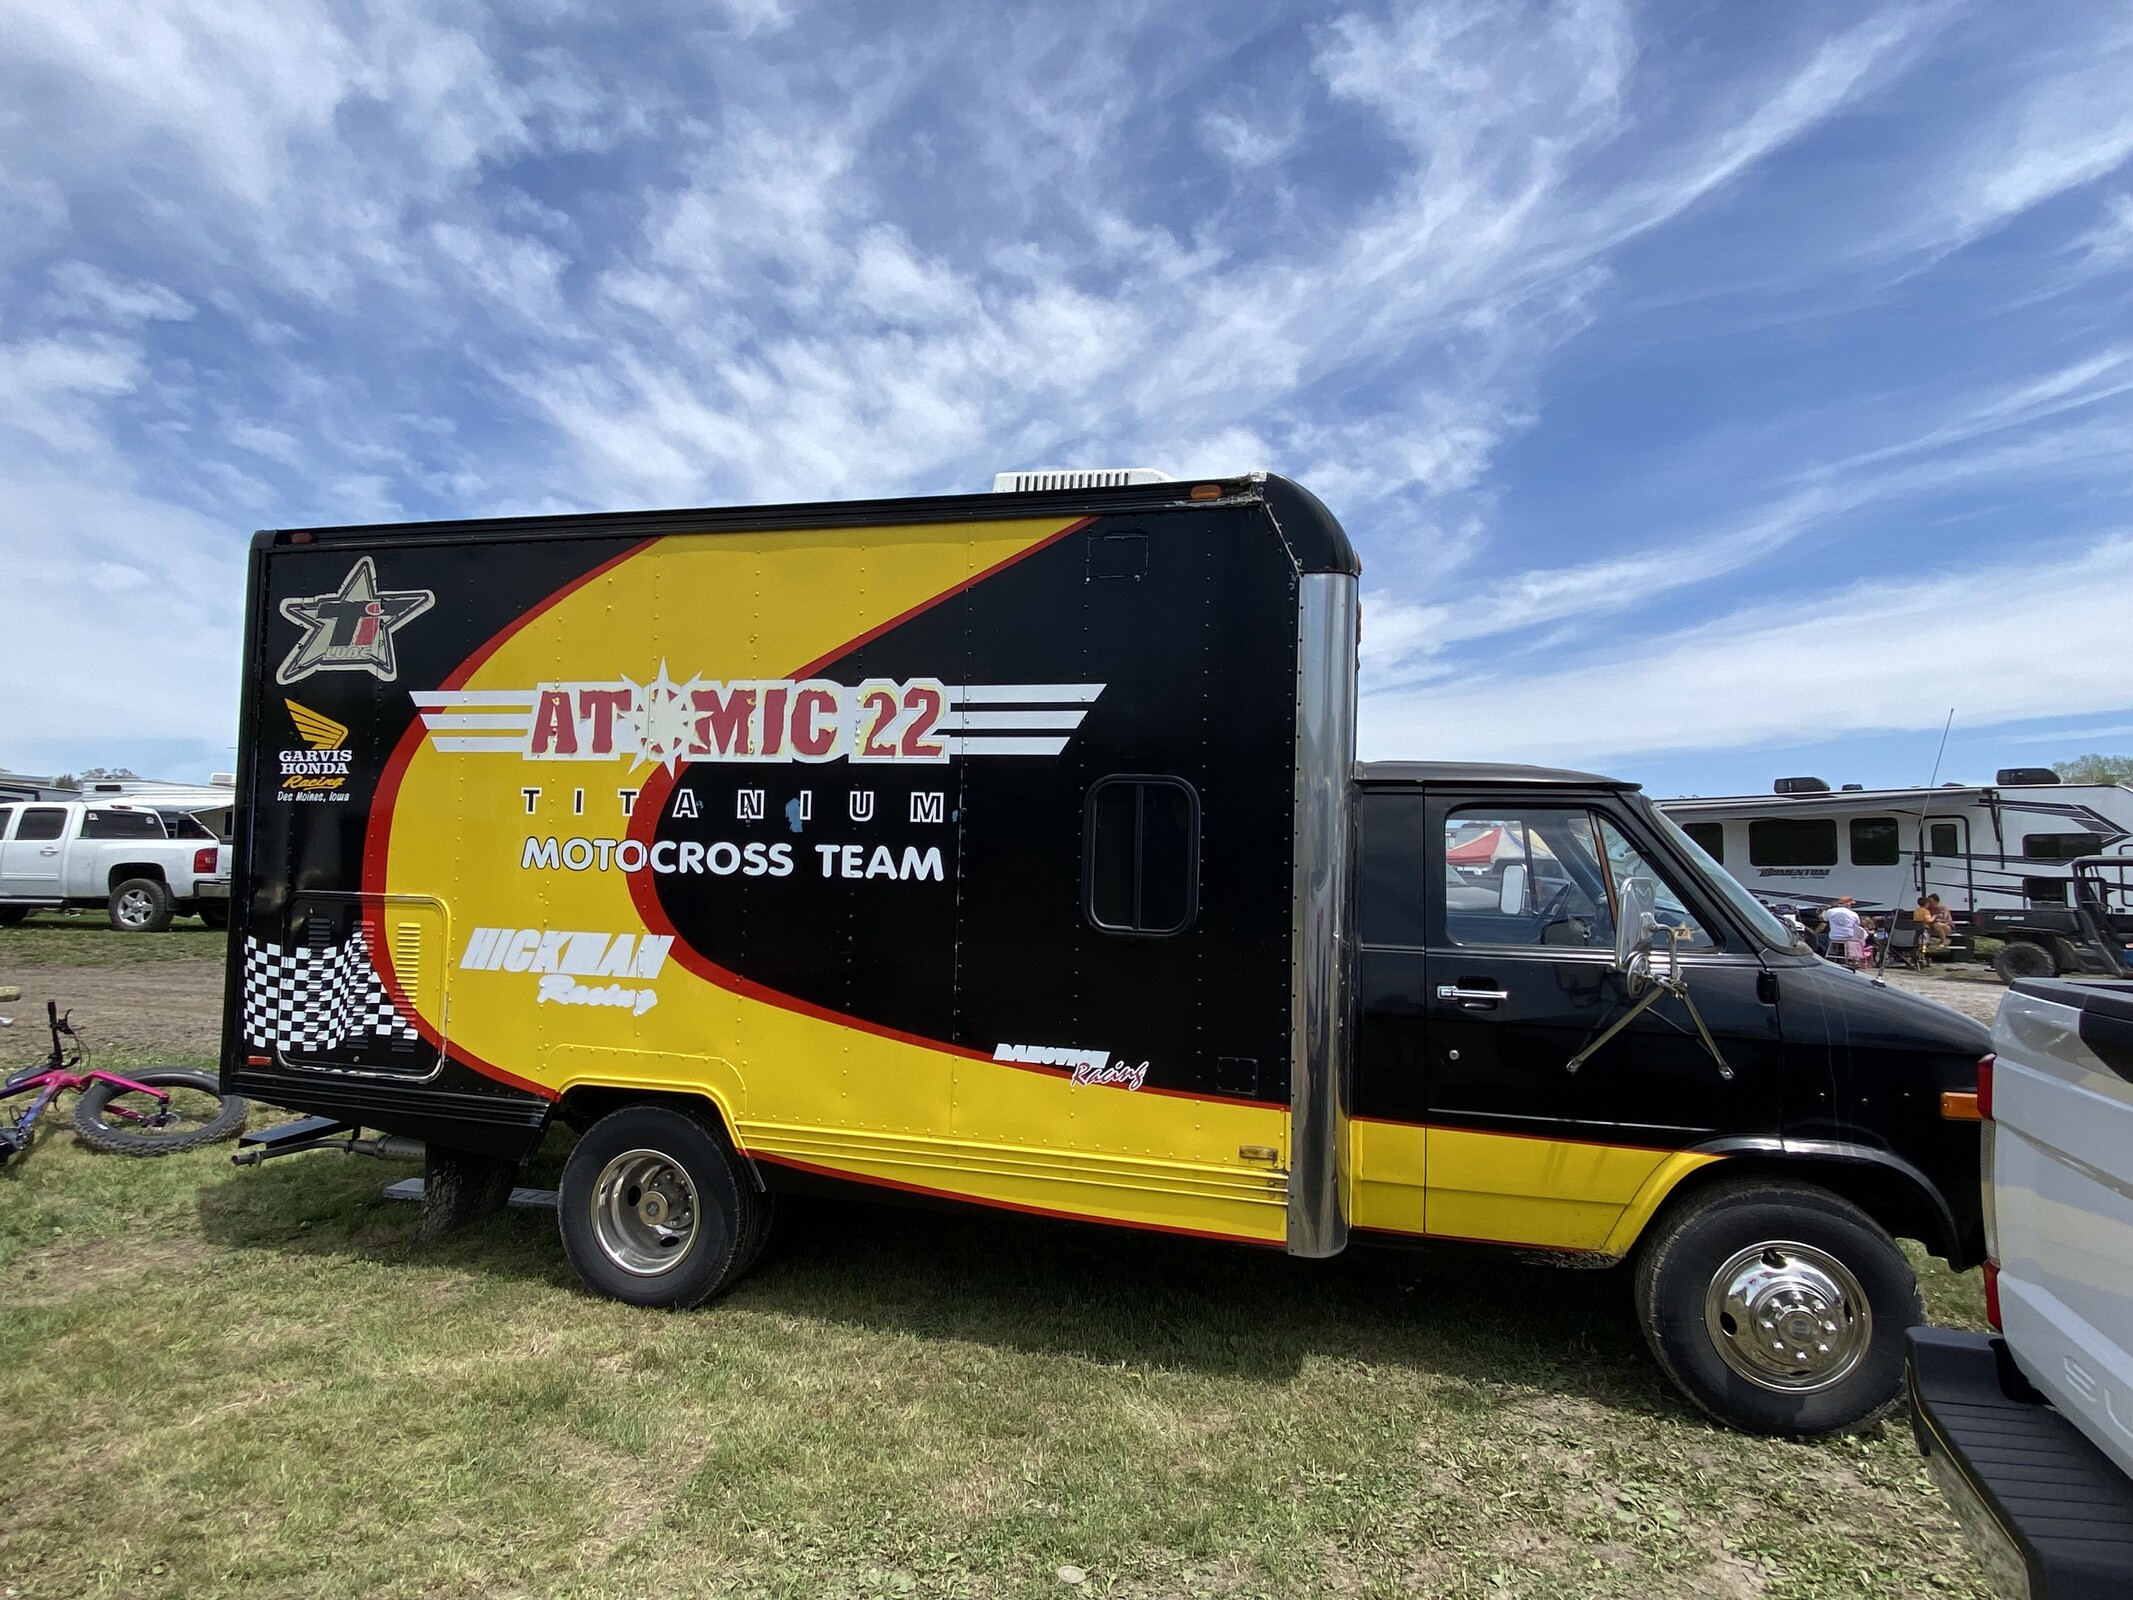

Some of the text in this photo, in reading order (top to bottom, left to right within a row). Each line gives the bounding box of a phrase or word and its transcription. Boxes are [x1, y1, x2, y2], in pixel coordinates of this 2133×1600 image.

[523, 678, 949, 763] ATOMIC 22
[278, 750, 353, 762] GARVIS
[280, 763, 350, 775] HONDA
[277, 791, 350, 803] Des Moines, Iowa
[282, 775, 346, 791] Racing
[521, 787, 945, 824] TITANIUM
[521, 836, 945, 882] MOTOCROSS TEAM
[459, 927, 676, 979] HICKMAN
[1070, 1060, 1149, 1091] Racing
